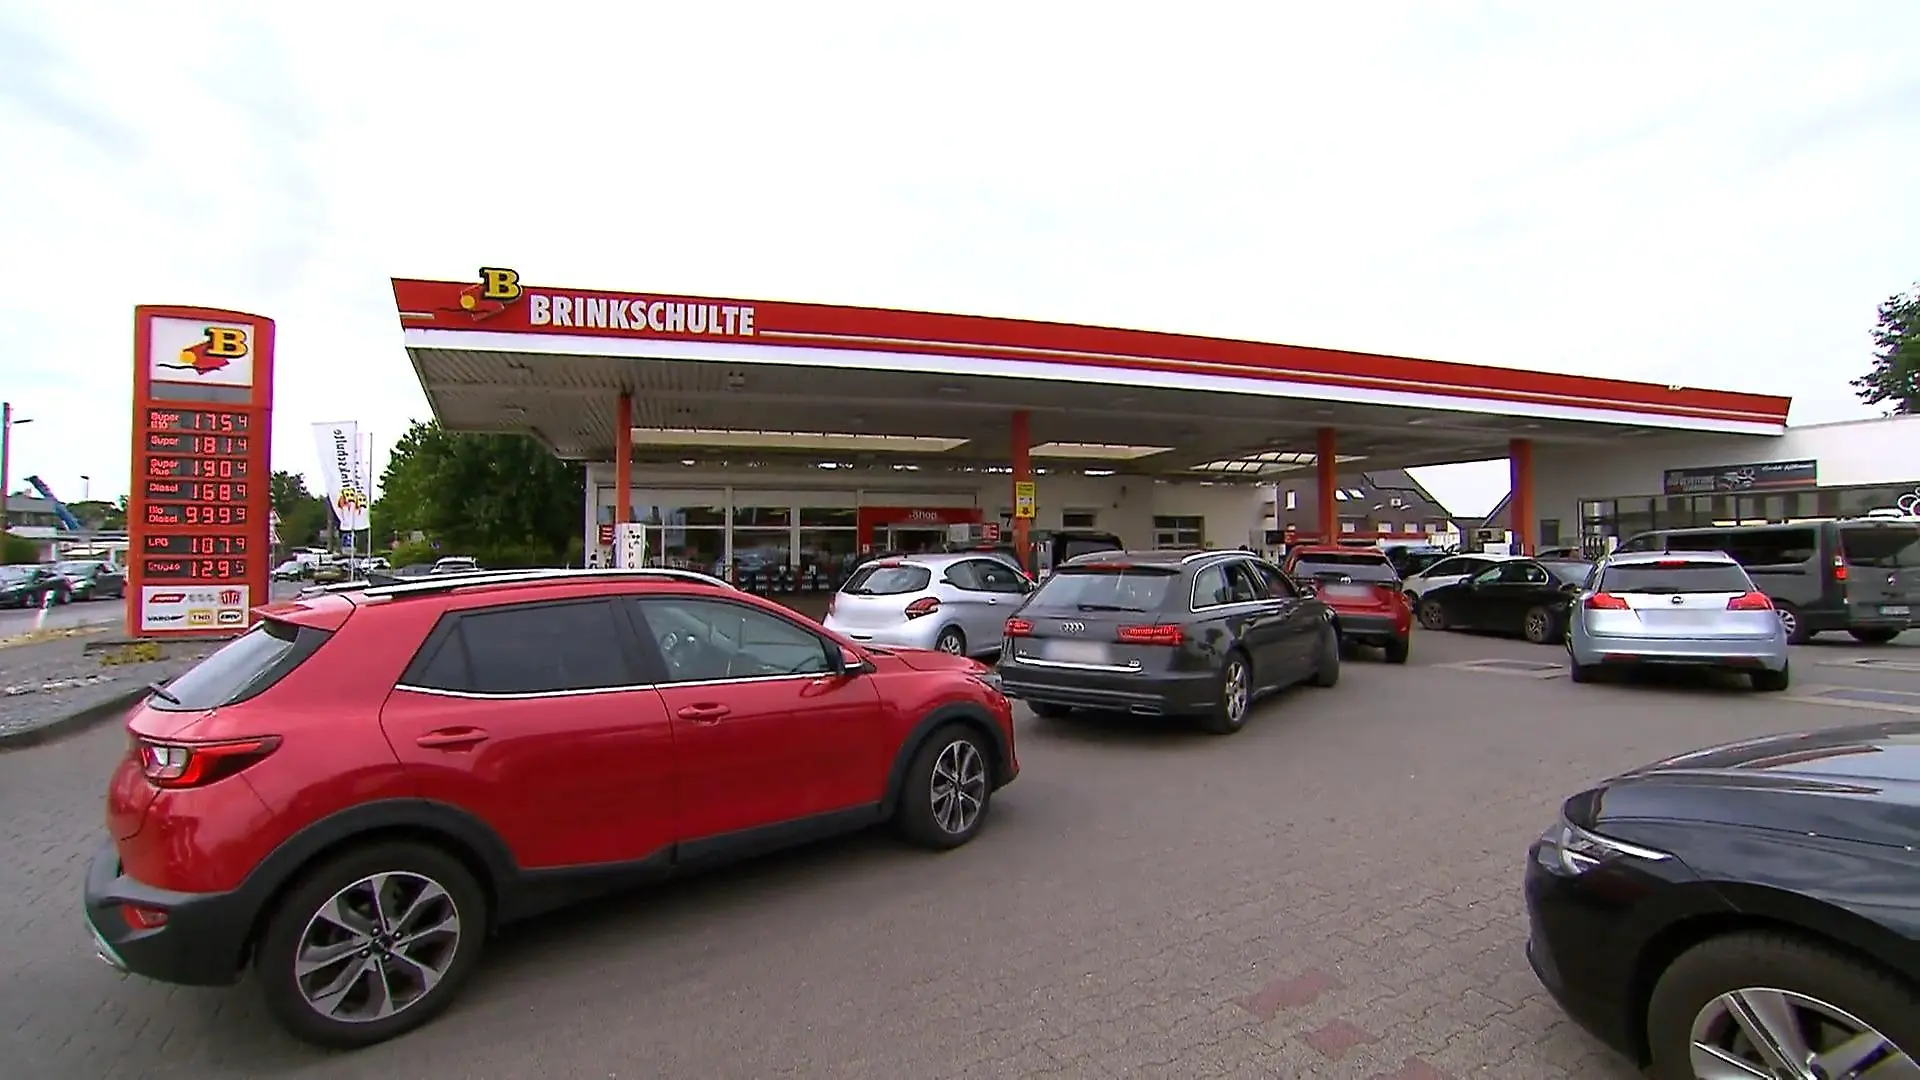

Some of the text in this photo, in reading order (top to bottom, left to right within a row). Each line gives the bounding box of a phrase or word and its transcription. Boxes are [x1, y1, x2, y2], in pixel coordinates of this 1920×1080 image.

[480, 267, 521, 300] B
[529, 294, 755, 336] BRINKSCHULTE
[204, 326, 249, 359] B
[150, 412, 179, 422] Super
[150, 435, 179, 446] Super
[150, 458, 178, 468] Super
[149, 483, 178, 492] Diesel
[148, 505, 164, 514] Bio
[148, 515, 178, 523] Diesel
[148, 538, 169, 547] LPG
